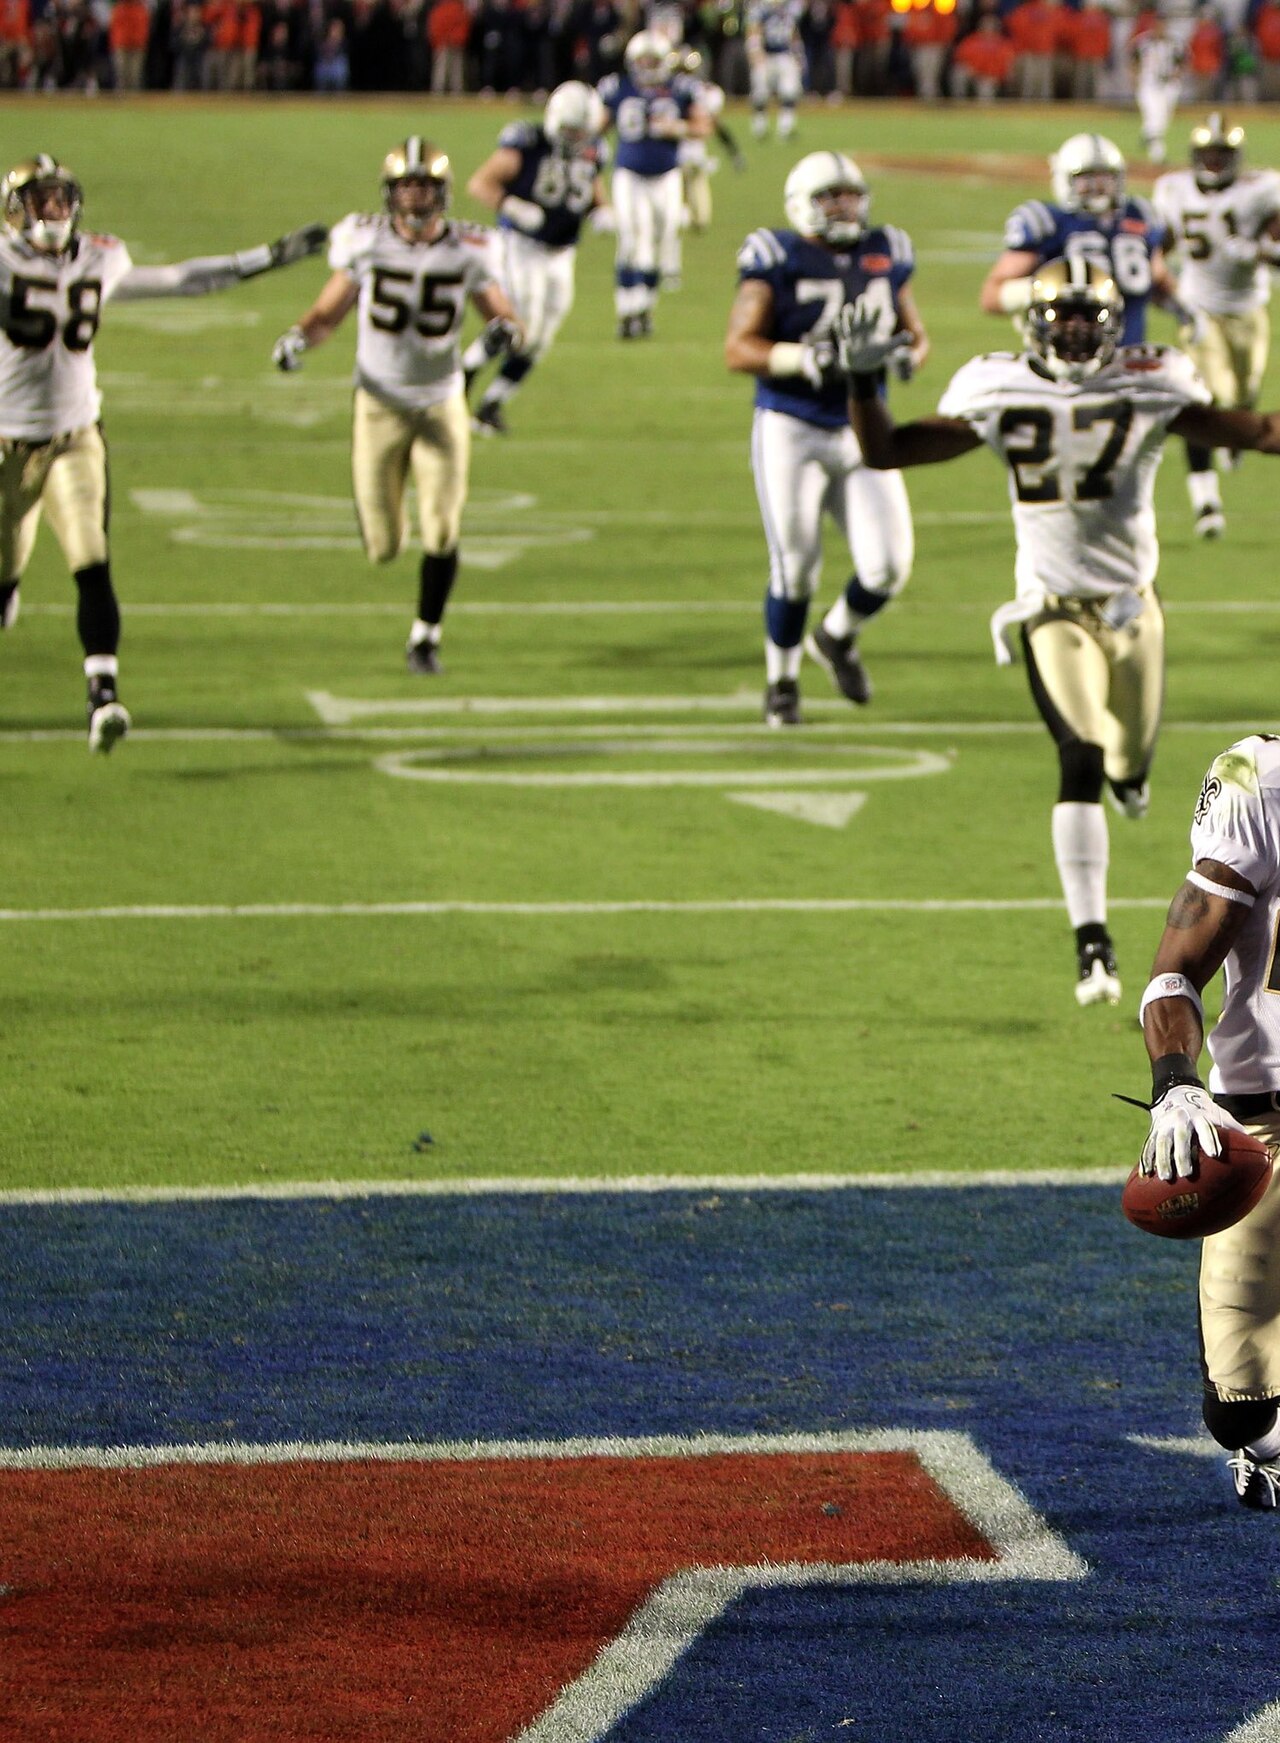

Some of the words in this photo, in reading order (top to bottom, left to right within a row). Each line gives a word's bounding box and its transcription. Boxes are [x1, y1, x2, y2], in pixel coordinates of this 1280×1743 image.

[6, 275, 102, 351] 58
[369, 265, 465, 337] 55
[999, 398, 1136, 504] 27
